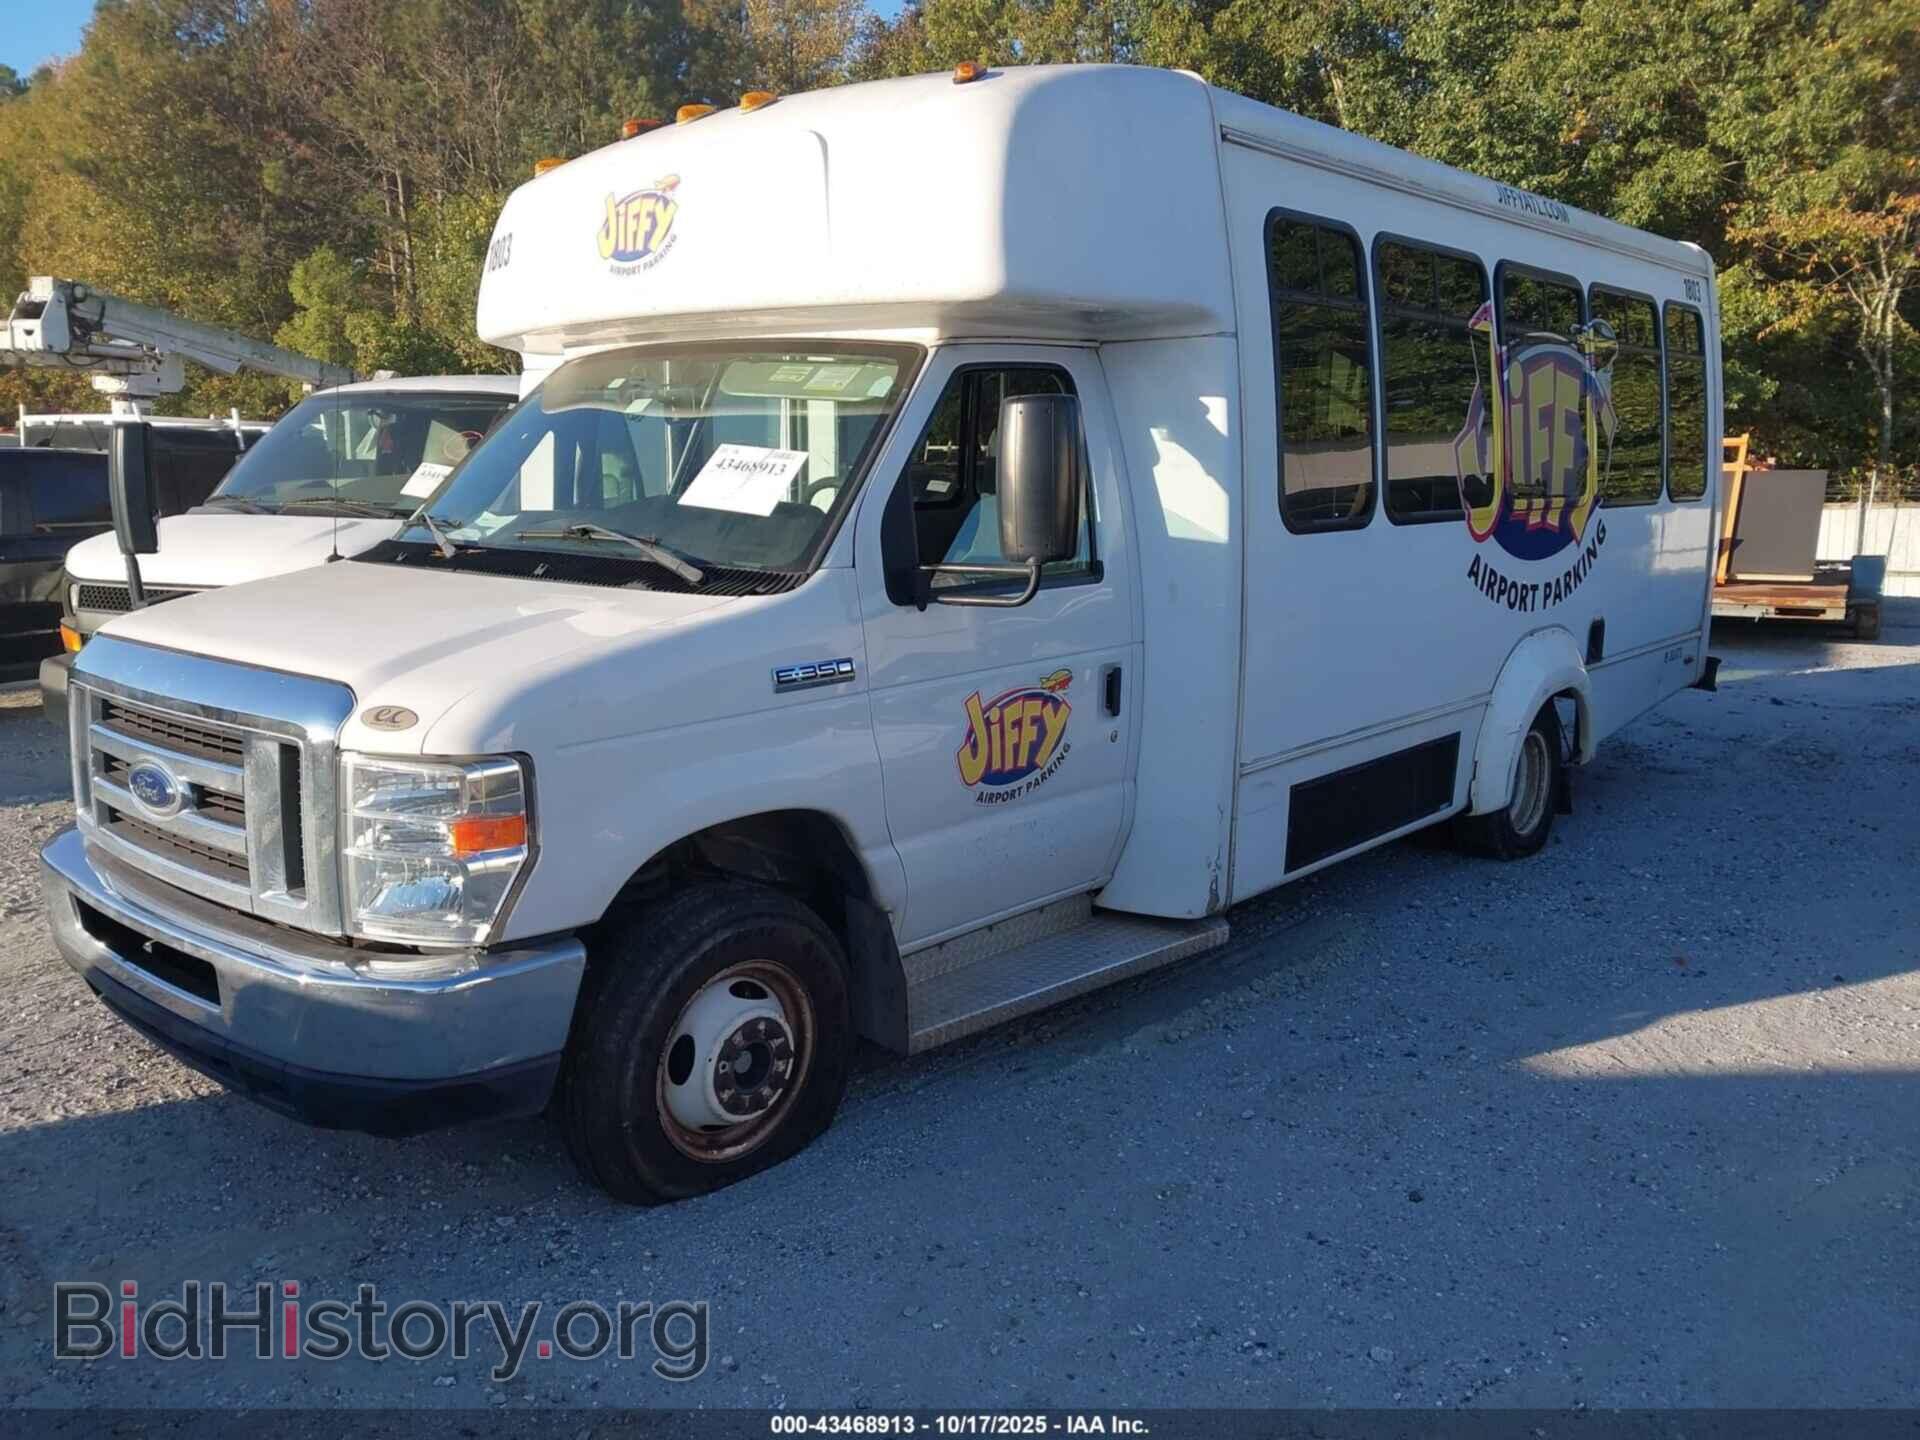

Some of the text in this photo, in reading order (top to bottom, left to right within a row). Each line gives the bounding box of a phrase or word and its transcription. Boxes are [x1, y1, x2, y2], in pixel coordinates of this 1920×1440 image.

[488, 232, 513, 272] 1803
[609, 233, 677, 277] AIRPORT PARKING
[1683, 278, 1701, 302] 1803
[715, 456, 787, 477] 43468913
[1467, 518, 1607, 613] AIRPORT PARKING
[976, 742, 1072, 805] AIRPORT PARKING
